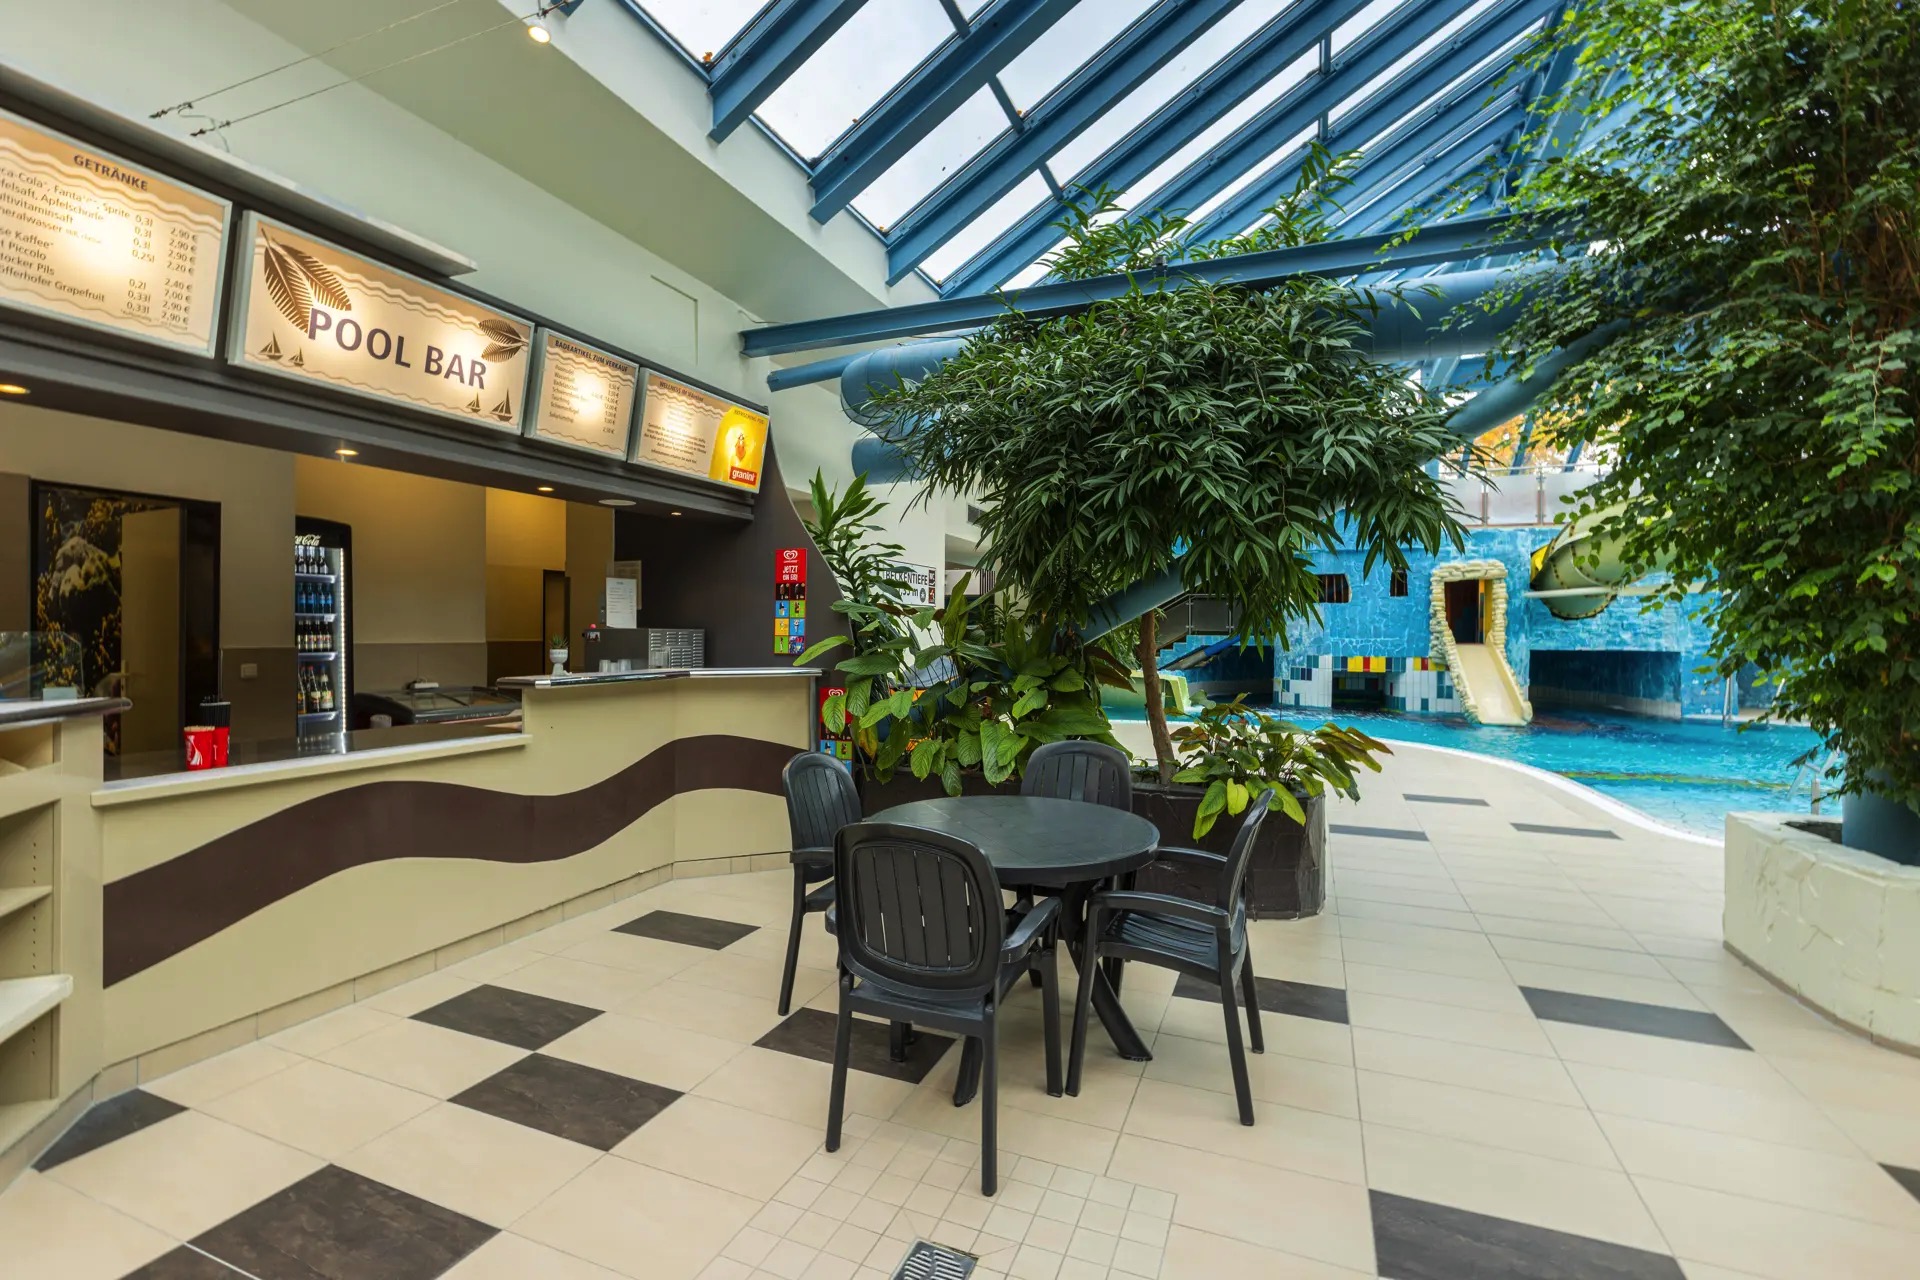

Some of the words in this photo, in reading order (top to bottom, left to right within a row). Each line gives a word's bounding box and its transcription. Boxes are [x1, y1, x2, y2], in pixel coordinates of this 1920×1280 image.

[74, 154, 148, 191] GETRÄNKE
[104, 202, 130, 219] Sprite
[9, 241, 47, 260] Piccolo
[37, 263, 55, 275] Pils
[54, 281, 105, 302] Grapefruit
[307, 307, 411, 369] POOL
[424, 344, 487, 390] BAR
[555, 340, 592, 359] BADEARTIKEL
[593, 354, 605, 364] ZUM
[605, 360, 628, 372] VERKAUF
[732, 469, 755, 481] granini
